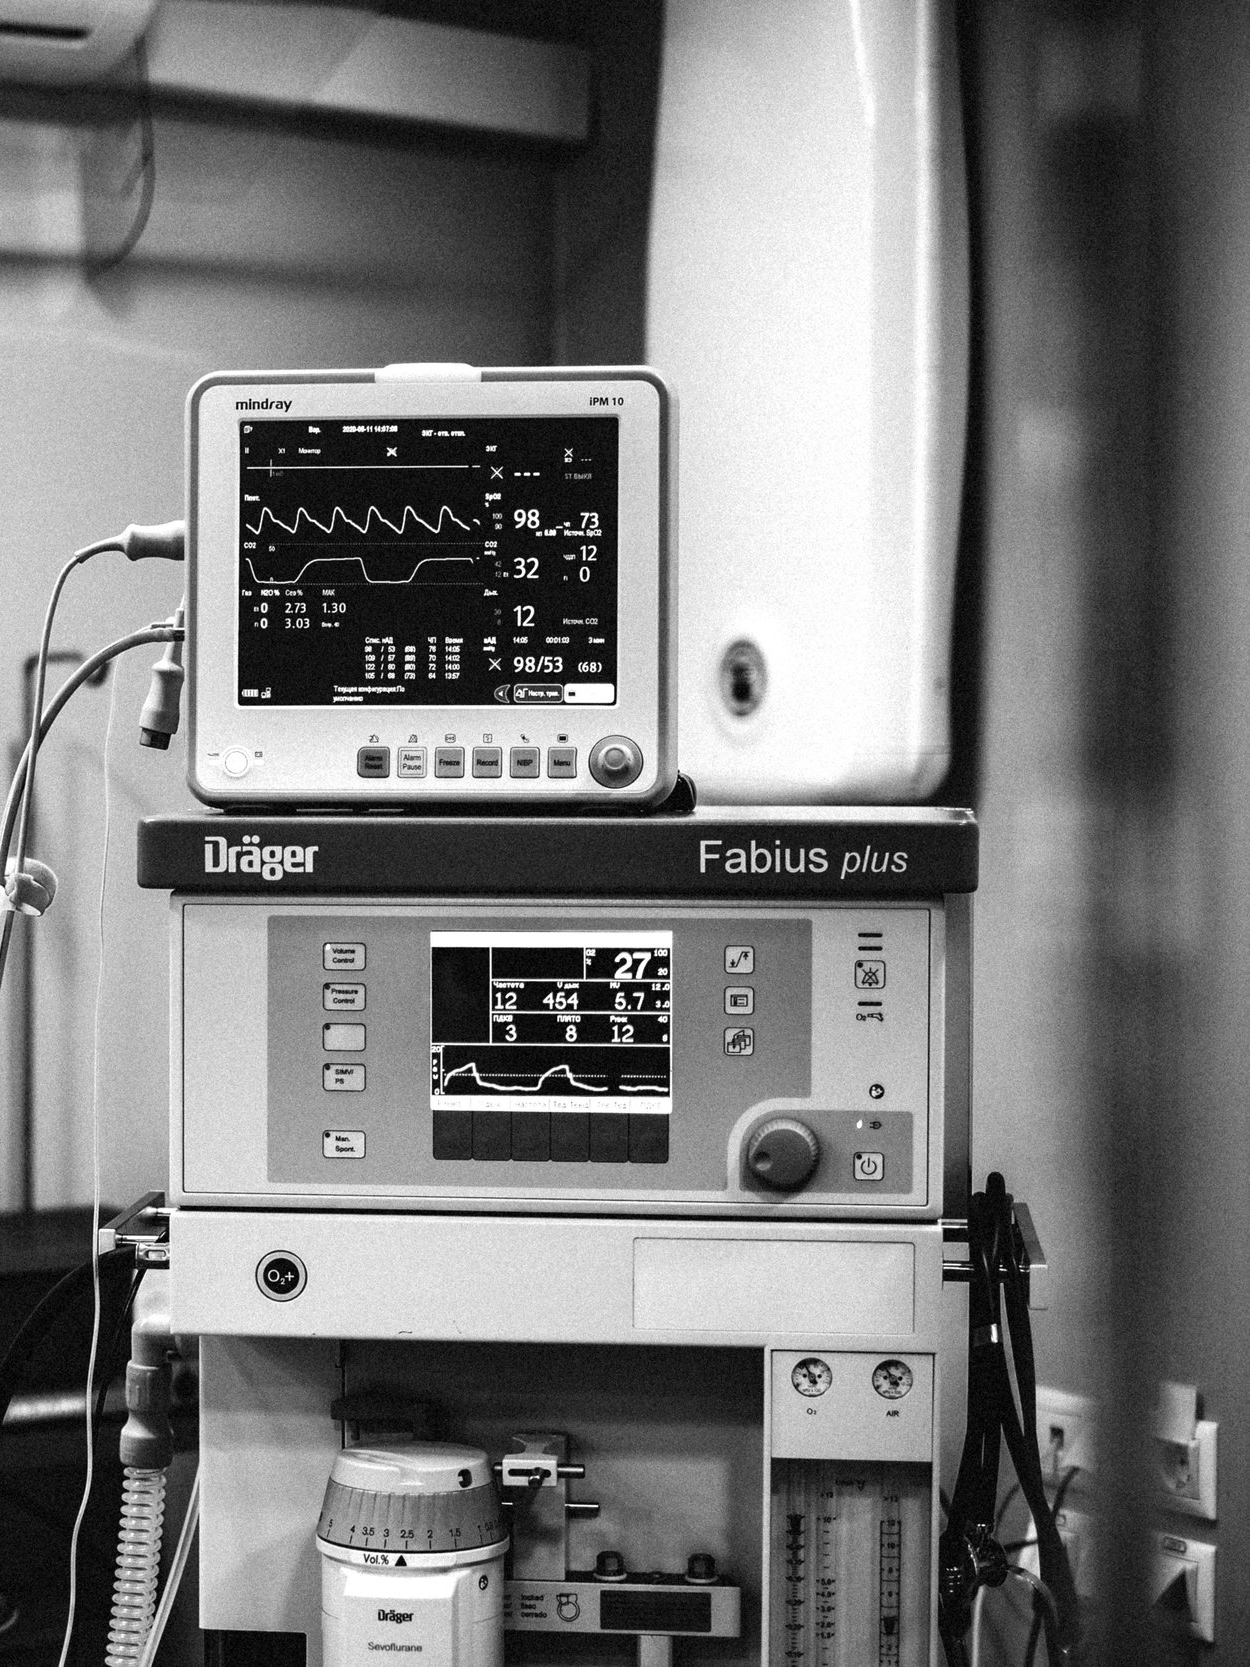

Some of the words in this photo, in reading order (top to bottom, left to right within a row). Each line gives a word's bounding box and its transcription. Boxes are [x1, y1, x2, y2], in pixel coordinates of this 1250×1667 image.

[236, 399, 292, 412] mindray
[590, 398, 608, 406] iPM
[612, 398, 623, 406] 10
[485, 493, 501, 501] SpO2
[514, 509, 540, 529] 98
[580, 512, 599, 528] 73
[580, 545, 597, 561] 12
[513, 558, 539, 579] 32
[579, 567, 590, 582] 0
[261, 603, 269, 613] 0
[285, 603, 307, 613] 2.73
[322, 603, 346, 613] 1.30
[261, 618, 269, 629] 0
[285, 618, 310, 629] 3.03
[513, 605, 535, 627] 12
[513, 656, 563, 673] 98/53
[578, 662, 602, 673] (68)
[204, 834, 319, 880] Dräger
[698, 839, 829, 875] Fabius
[840, 843, 909, 881] plus
[654, 949, 668, 957] 100
[614, 951, 652, 979] 27
[658, 968, 668, 976] 20
[493, 981, 525, 989] Частота
[494, 992, 517, 1009] 12
[543, 992, 579, 1010] 454
[614, 992, 645, 1010] 5.7
[557, 1015, 581, 1023] ПЛАТО
[505, 1025, 517, 1042] 3
[565, 1025, 577, 1042] 8
[611, 1025, 634, 1042] 12
[328, 1519, 333, 1528] 5
[350, 1525, 356, 1533] 4
[362, 1526, 375, 1536] 3.5
[383, 1529, 389, 1537] 3
[400, 1530, 414, 1538] 2.5
[427, 1530, 433, 1538] 2
[449, 1528, 461, 1537] 1.5
[363, 1554, 389, 1565] Vol.%
[378, 1609, 414, 1623] Dräger
[368, 1642, 423, 1652] Sevoflurane
